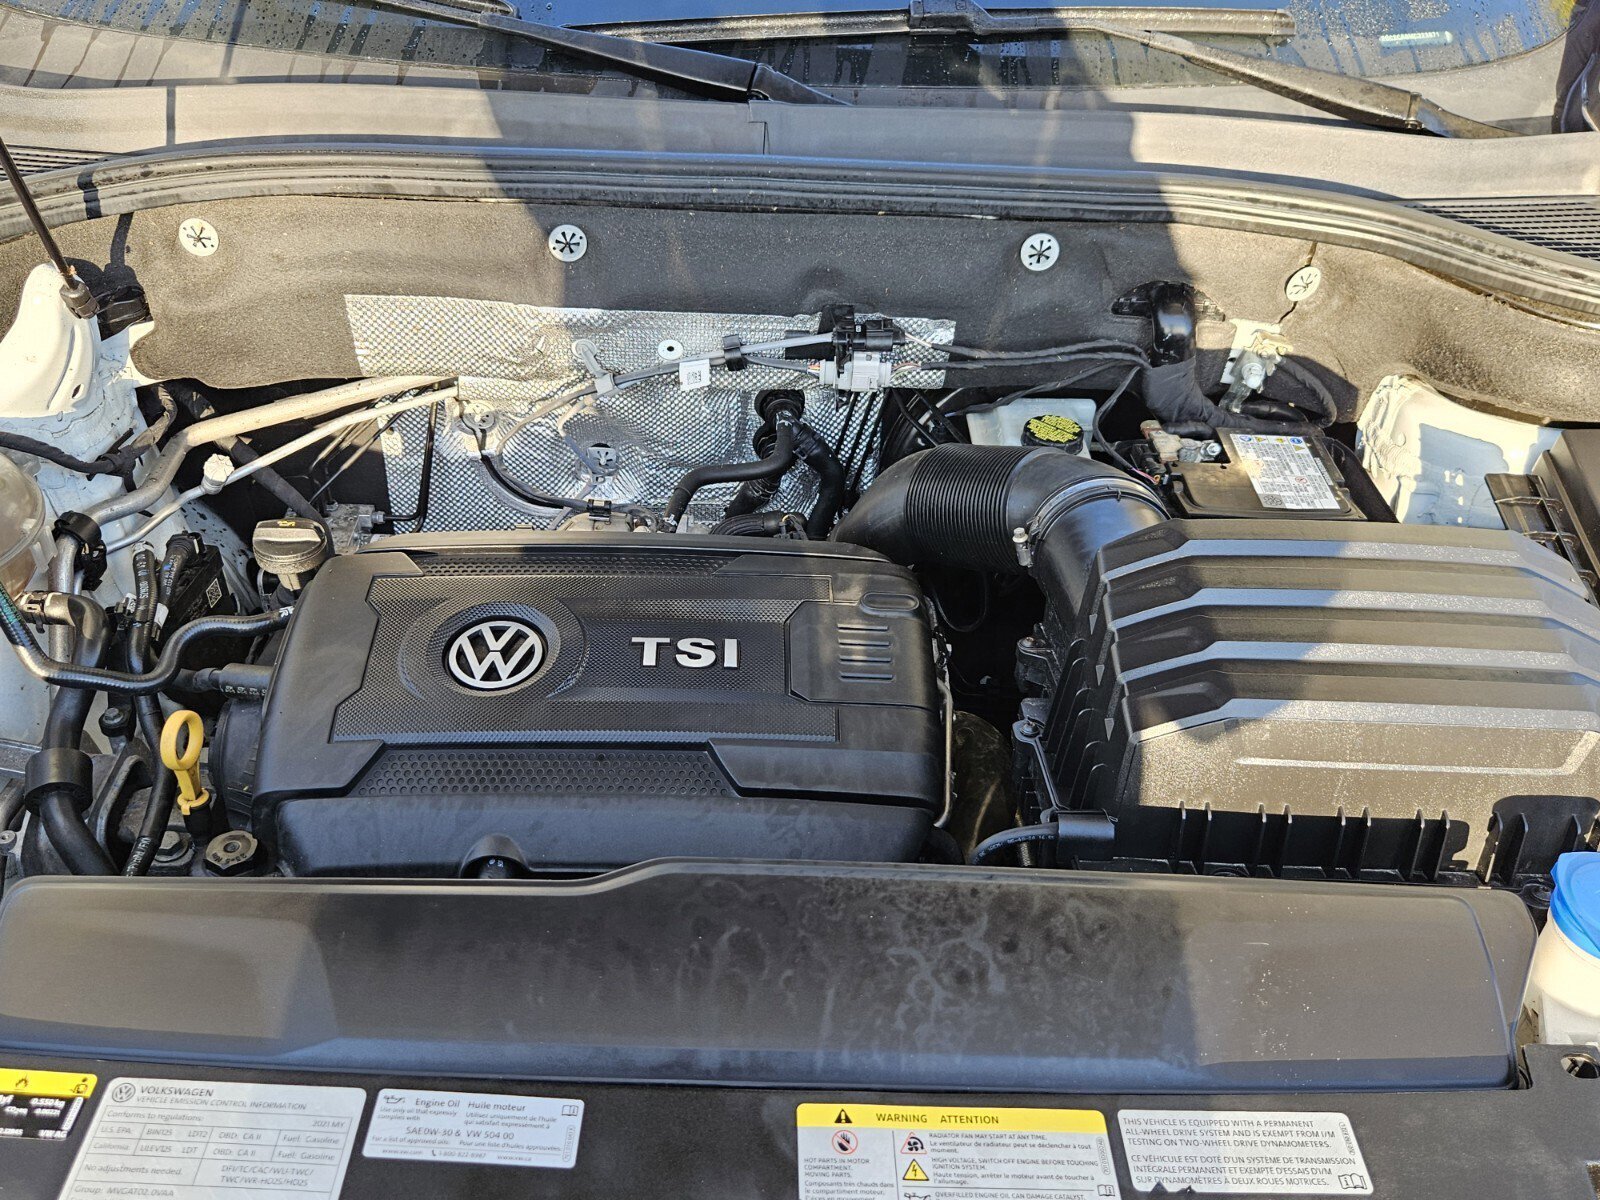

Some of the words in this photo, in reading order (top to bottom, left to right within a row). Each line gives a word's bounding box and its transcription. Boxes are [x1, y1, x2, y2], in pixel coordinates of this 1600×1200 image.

[631, 636, 738, 668] TSI
[141, 1086, 214, 1096] VOLKSWAGEN
[210, 1100, 247, 1108] CONTROL
[415, 1098, 445, 1108] Engine
[468, 1101, 491, 1109] Huile
[107, 1110, 145, 1118] Conforms
[876, 1113, 927, 1123] WARNING
[940, 1115, 999, 1124] ATTENTION
[1142, 1118, 1177, 1126] VEHICLE
[1179, 1118, 1186, 1126] IS
[1189, 1118, 1230, 1126] EQUIPPED
[466, 1130, 481, 1138] VW
[484, 1131, 500, 1139] 504
[1125, 1128, 1172, 1136] ALL-WHEEL
[306, 1136, 339, 1144] Gasoline
[1127, 1138, 1162, 1146] TESTING
[301, 1152, 335, 1160] Gasoline
[1184, 1155, 1199, 1163] EST
[1224, 1156, 1245, 1164] D'UN
[1295, 1157, 1356, 1165] TRANSMISSION
[98, 1165, 149, 1174] adjustments
[1178, 1166, 1227, 1174] PERMANENT
[1276, 1167, 1310, 1175] D'ESSAIS
[1232, 1177, 1254, 1185] DEUX
[74, 1186, 103, 1195] Group:
